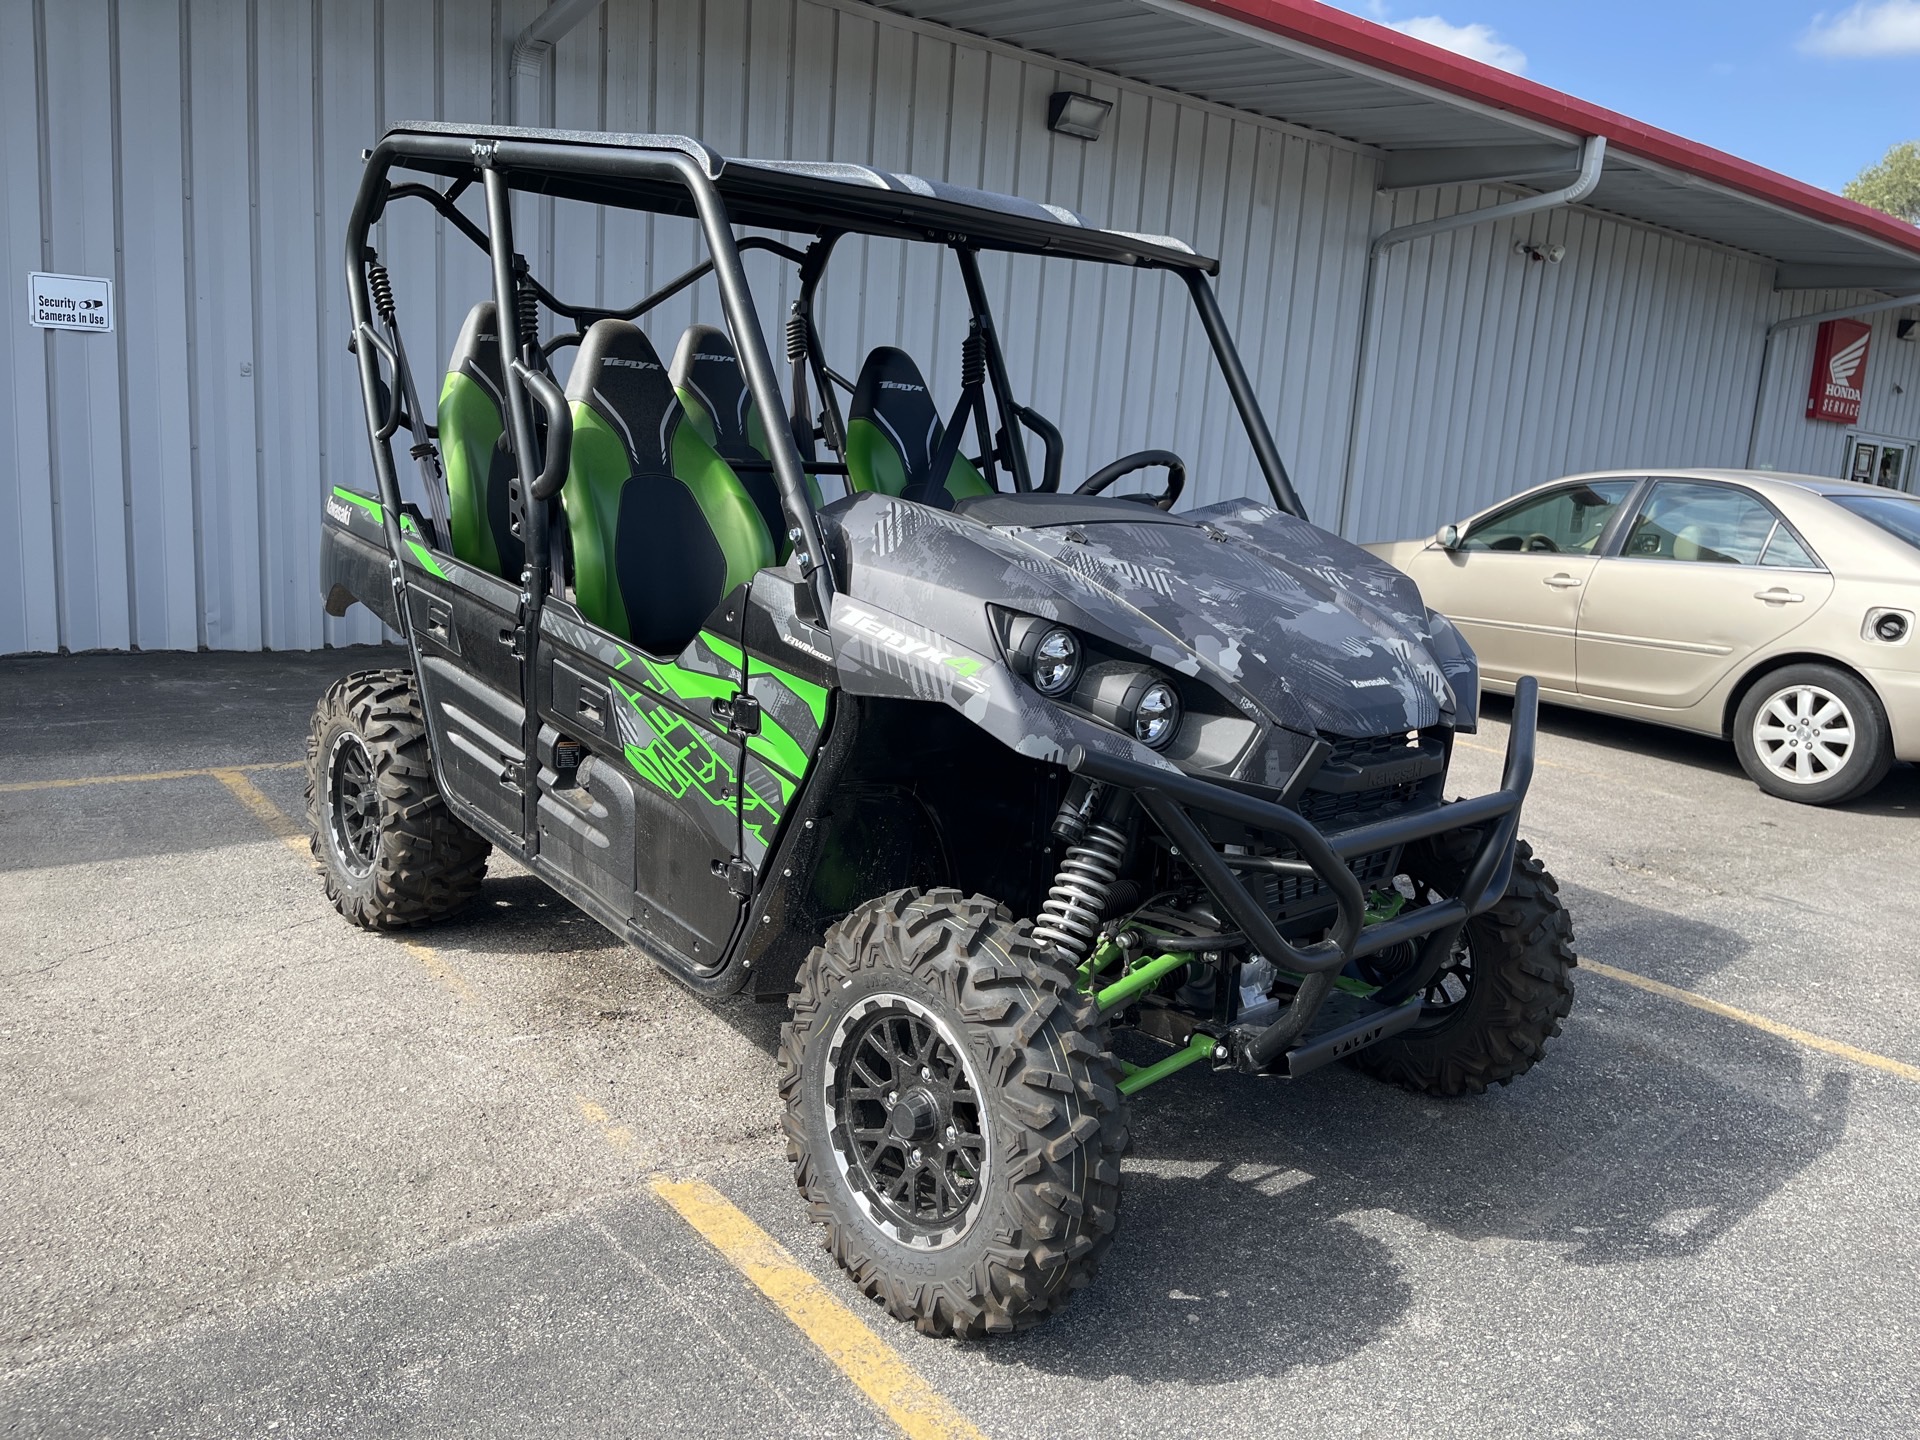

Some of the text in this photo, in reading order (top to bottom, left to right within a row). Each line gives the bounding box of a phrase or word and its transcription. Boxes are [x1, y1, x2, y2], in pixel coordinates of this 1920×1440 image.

[39, 295, 76, 311] Security
[39, 309, 104, 325] Cameras In Use
[1825, 383, 1861, 402] HONDA
[1822, 398, 1860, 417] SERVICE
[1350, 676, 1390, 689] Kawasaki
[1367, 761, 1423, 788] Kawasaki
